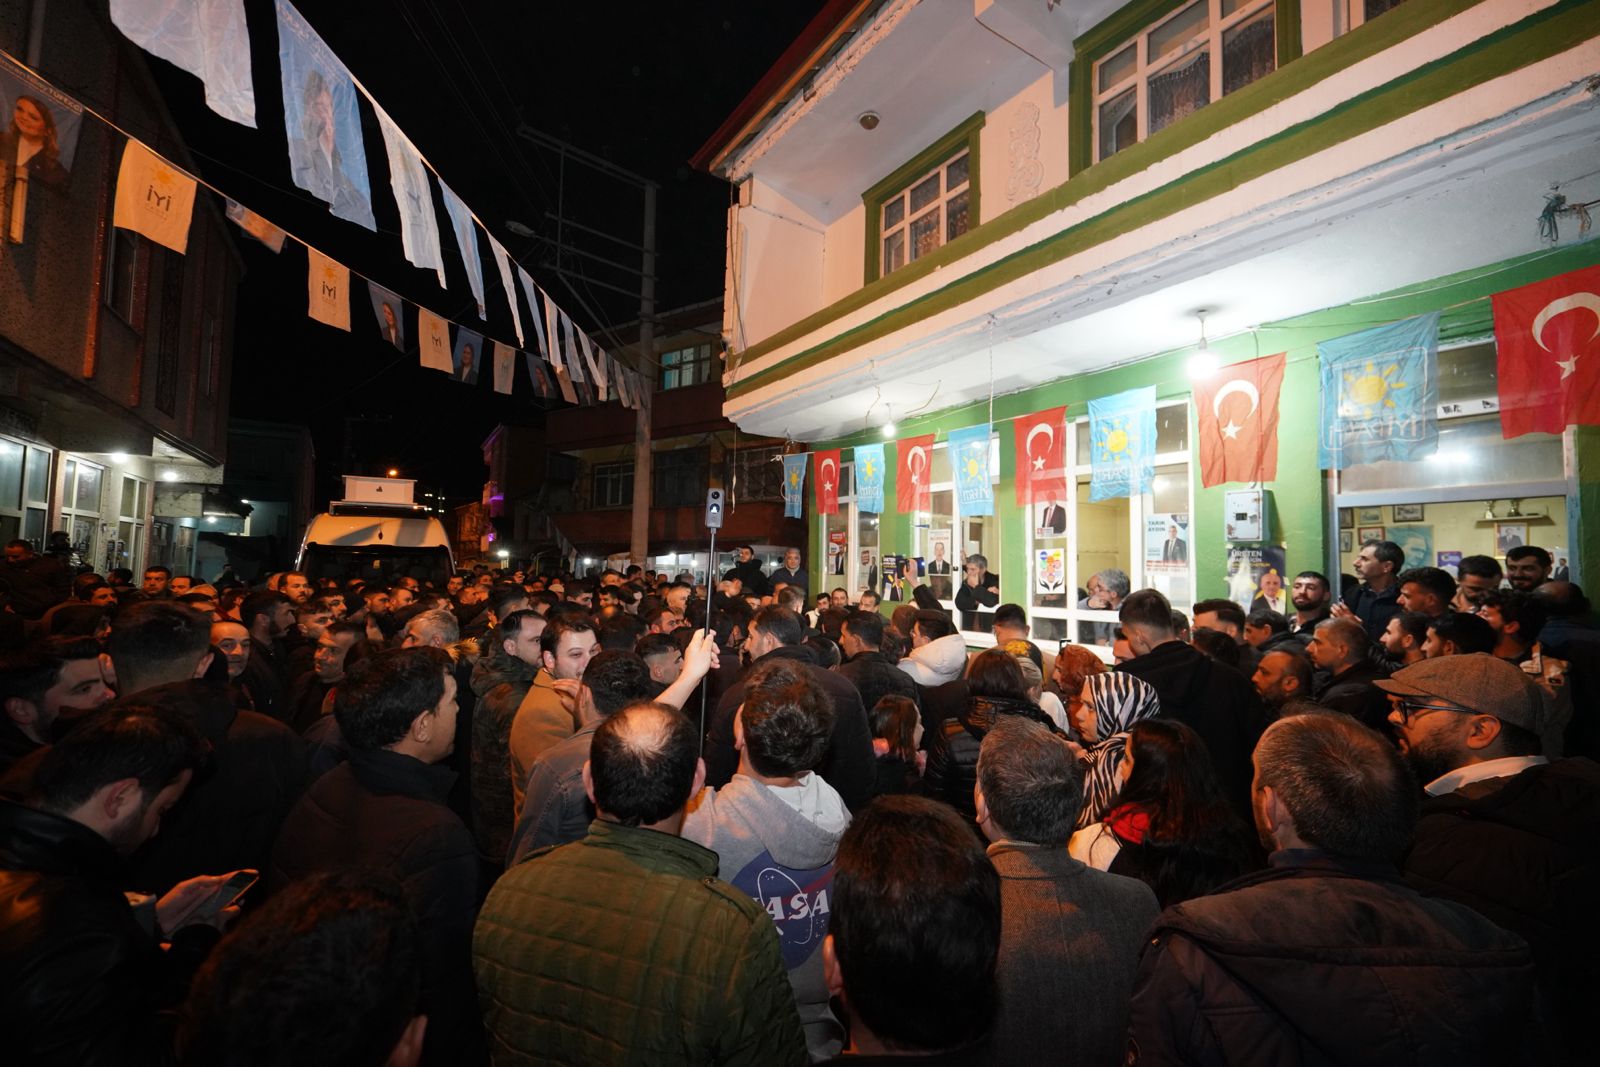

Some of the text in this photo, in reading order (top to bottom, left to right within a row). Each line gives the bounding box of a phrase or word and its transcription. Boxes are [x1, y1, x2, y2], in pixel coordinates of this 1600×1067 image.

[147, 184, 172, 212] İYİ
[322, 281, 336, 300] İYİ
[752, 889, 830, 921] ASA
